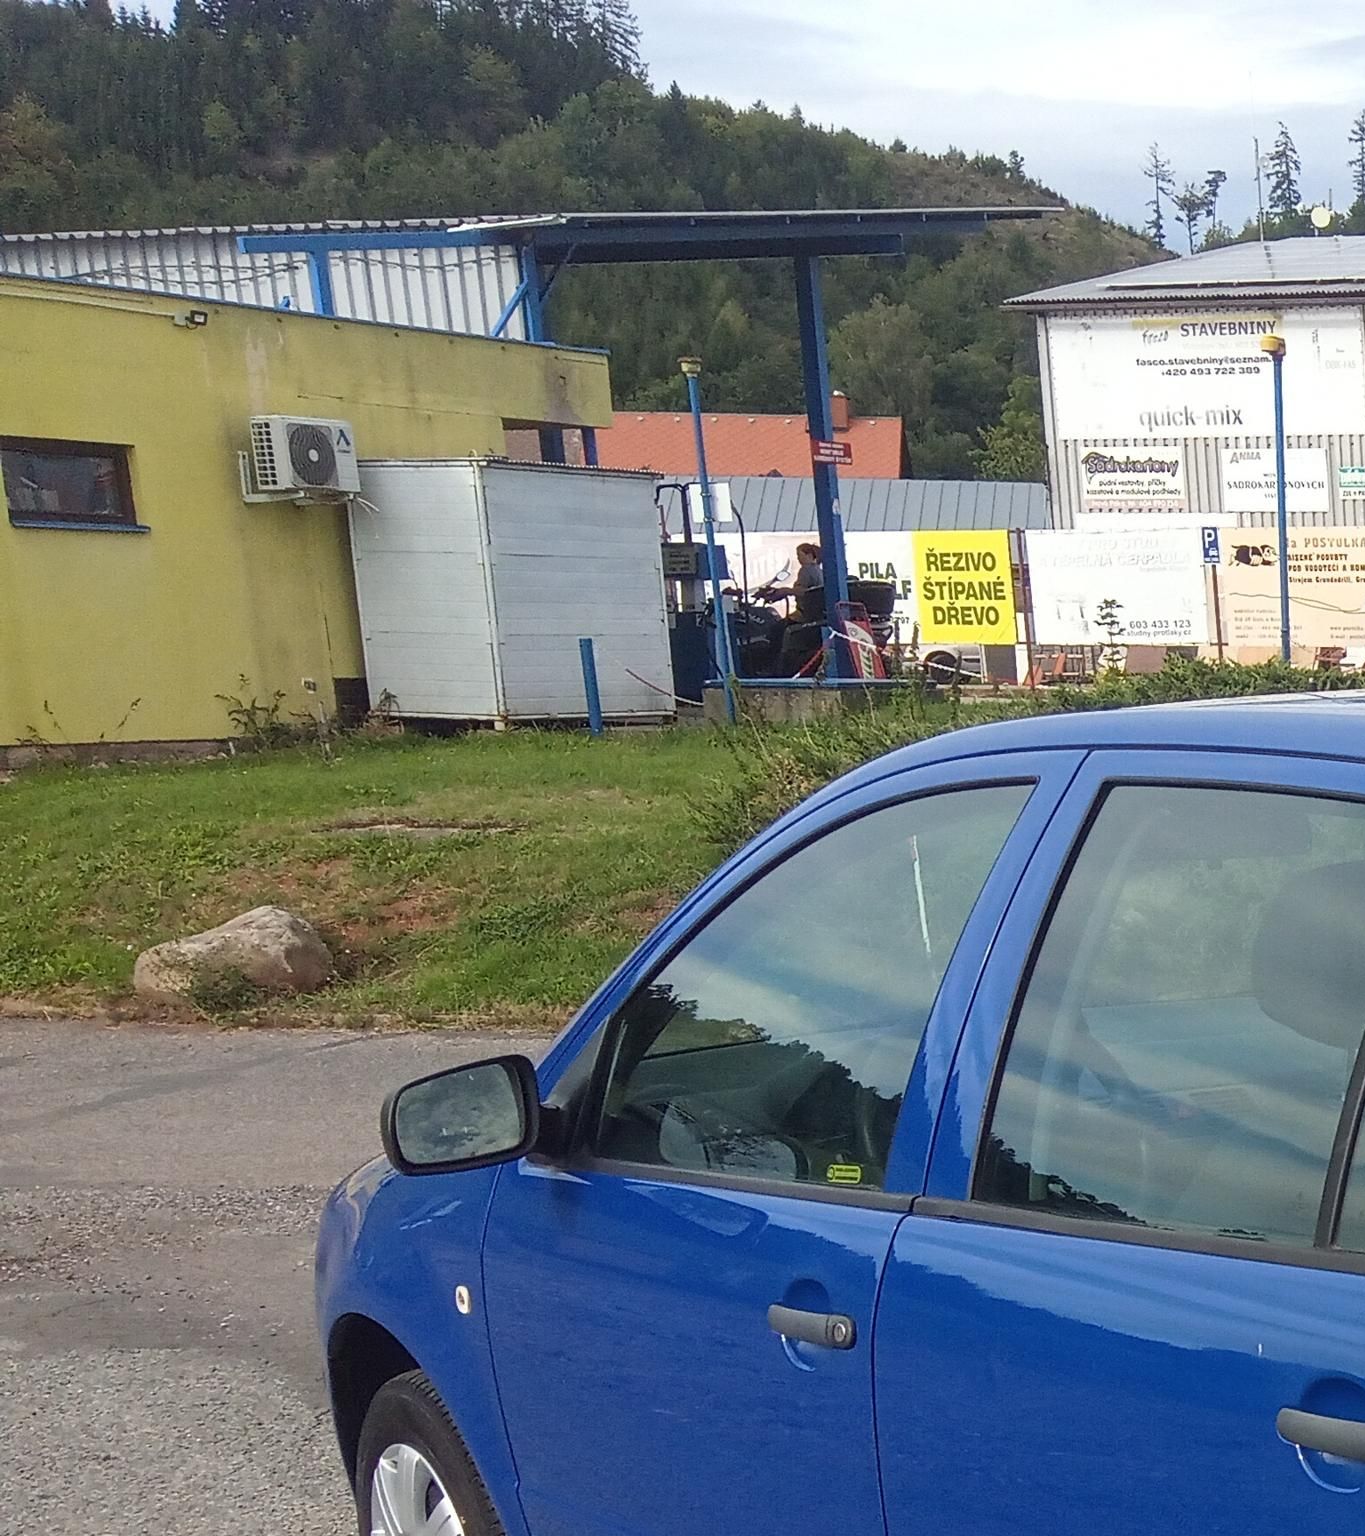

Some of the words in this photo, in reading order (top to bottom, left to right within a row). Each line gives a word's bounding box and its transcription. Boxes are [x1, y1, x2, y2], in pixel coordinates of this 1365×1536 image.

[1180, 320, 1277, 337] STAVEBNINY
[1139, 404, 1244, 432] quick-mix
[859, 562, 898, 580] PILA
[925, 548, 997, 572] ŘEZIVO
[923, 576, 1006, 601] ŠTÍPANÉ
[932, 602, 1000, 626] DŘEVO
[1129, 620, 1149, 629] 603
[1173, 619, 1192, 628] 123
